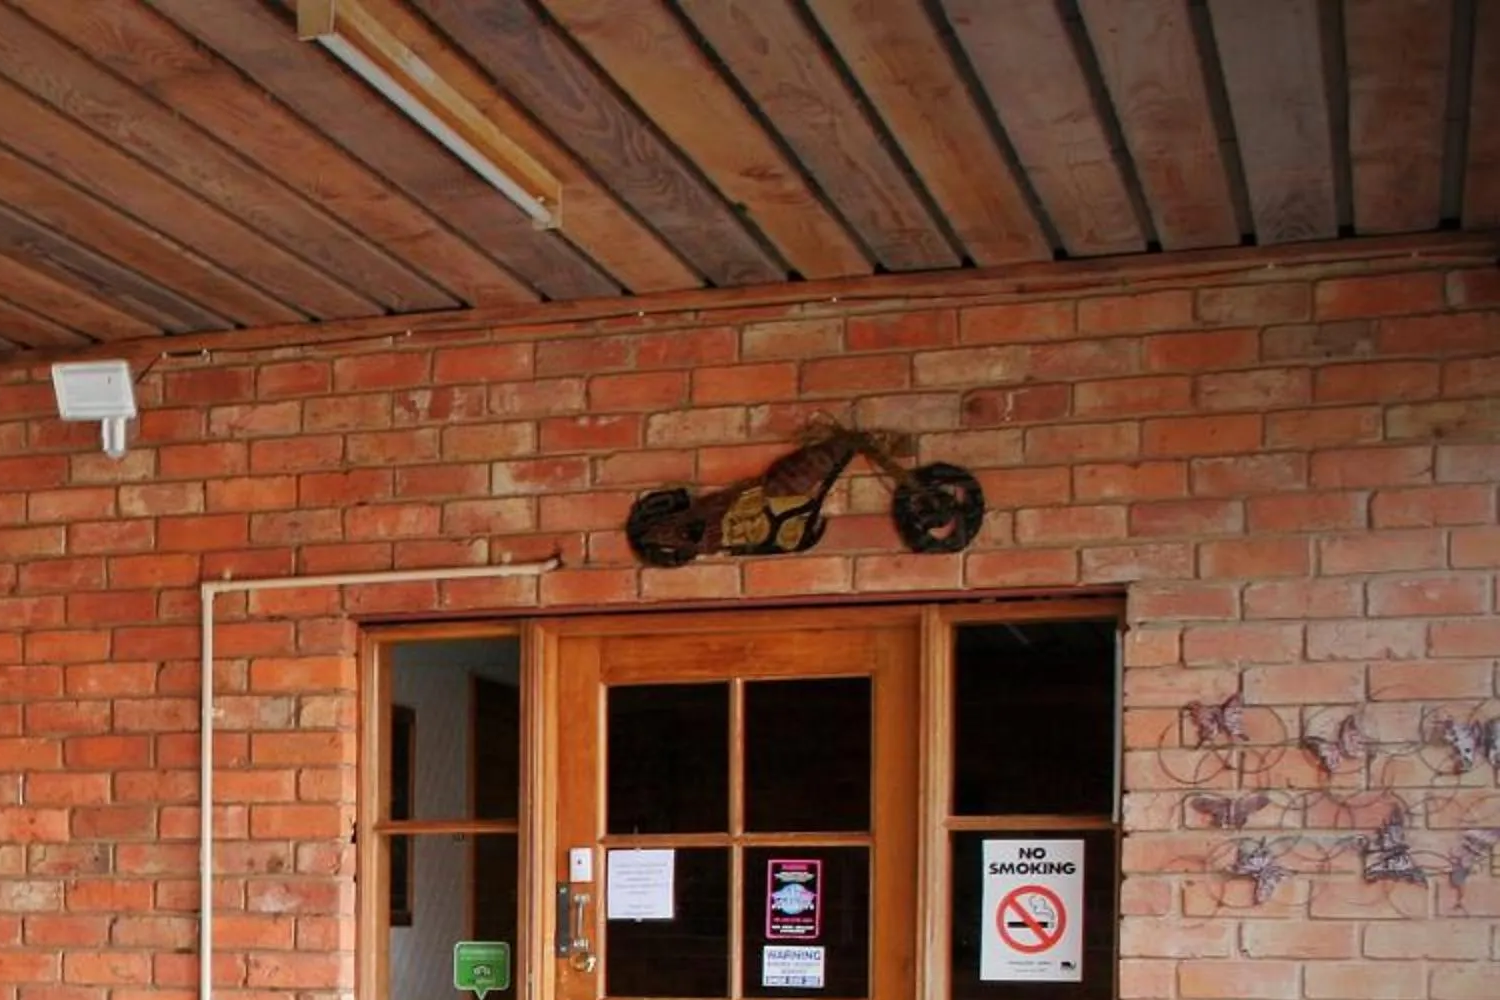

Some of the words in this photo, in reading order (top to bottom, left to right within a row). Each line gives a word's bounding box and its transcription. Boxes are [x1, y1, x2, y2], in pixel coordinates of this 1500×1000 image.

[1019, 847, 1047, 859] NO
[988, 862, 1077, 875] SMOKING
[767, 950, 821, 961] WARNING
